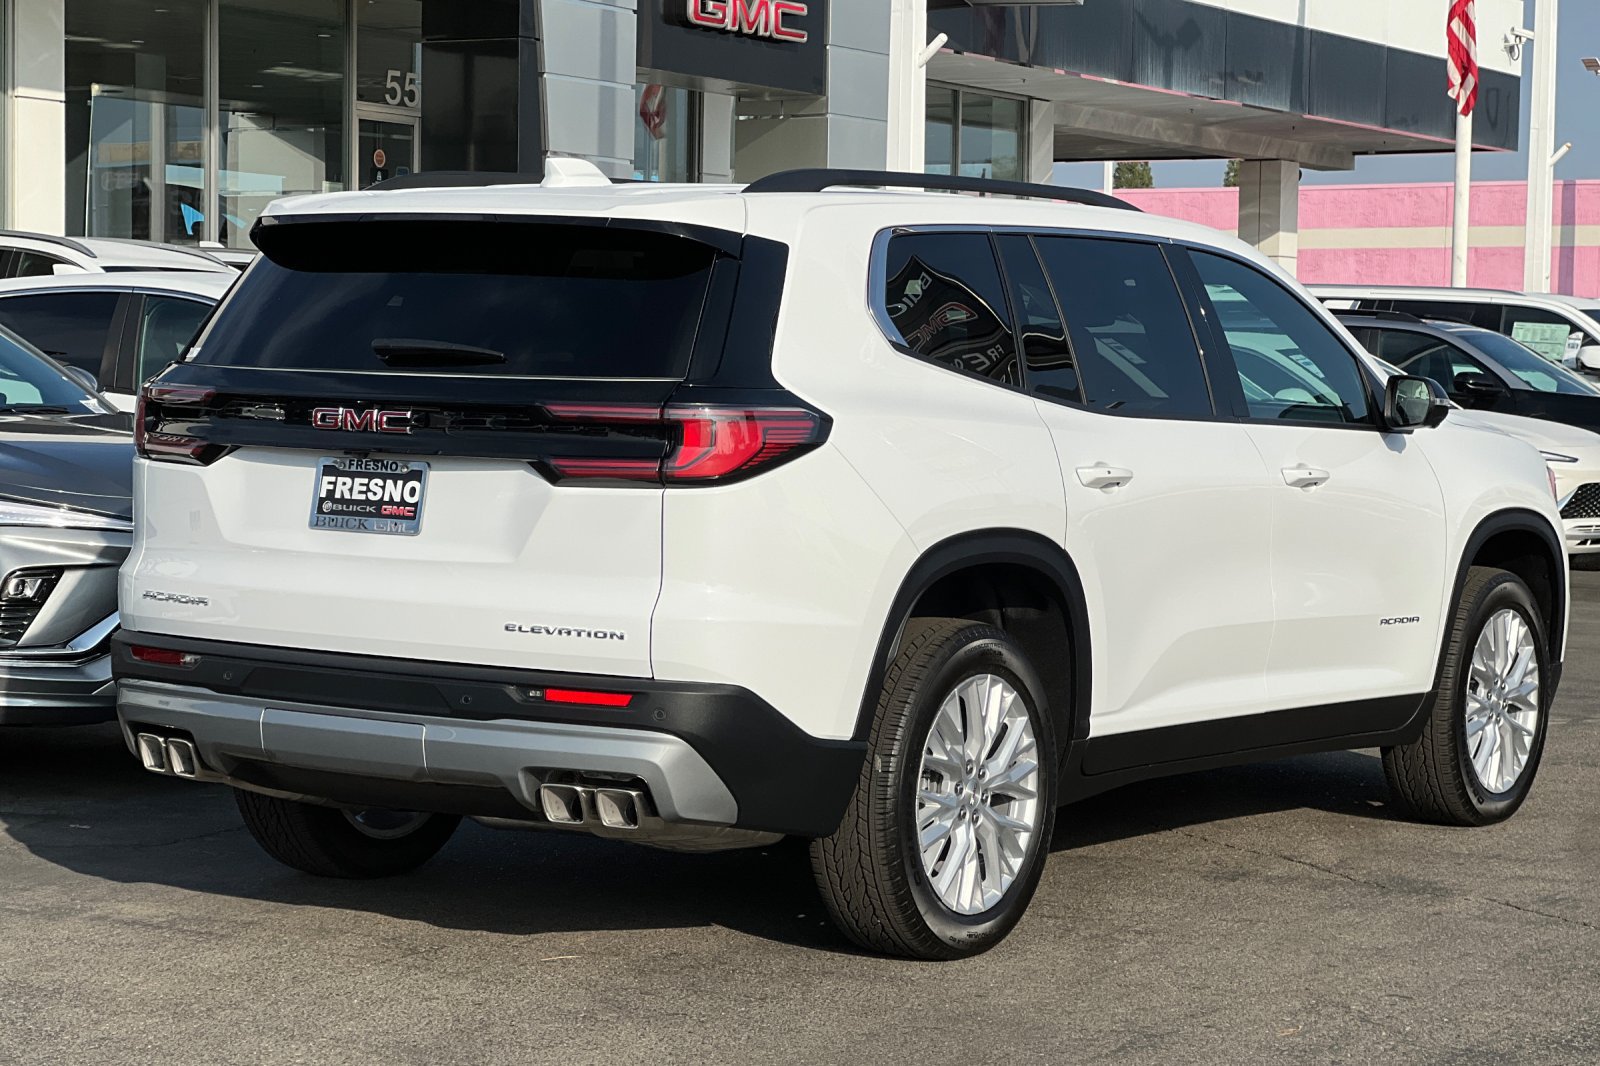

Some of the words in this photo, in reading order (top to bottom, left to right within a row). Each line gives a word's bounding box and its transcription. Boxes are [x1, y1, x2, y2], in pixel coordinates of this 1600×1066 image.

[687, 0, 808, 43] GMC
[385, 69, 420, 107] 55
[312, 407, 412, 434] GMC
[348, 459, 399, 472] FRESNO
[319, 475, 421, 504] FRESNO
[332, 504, 376, 513] BUICK
[381, 505, 415, 516] GMC
[314, 515, 369, 530] BUICK
[142, 590, 208, 607] ACADIA
[1379, 616, 1420, 626] ACADIA
[504, 623, 625, 641] ELEVATION
